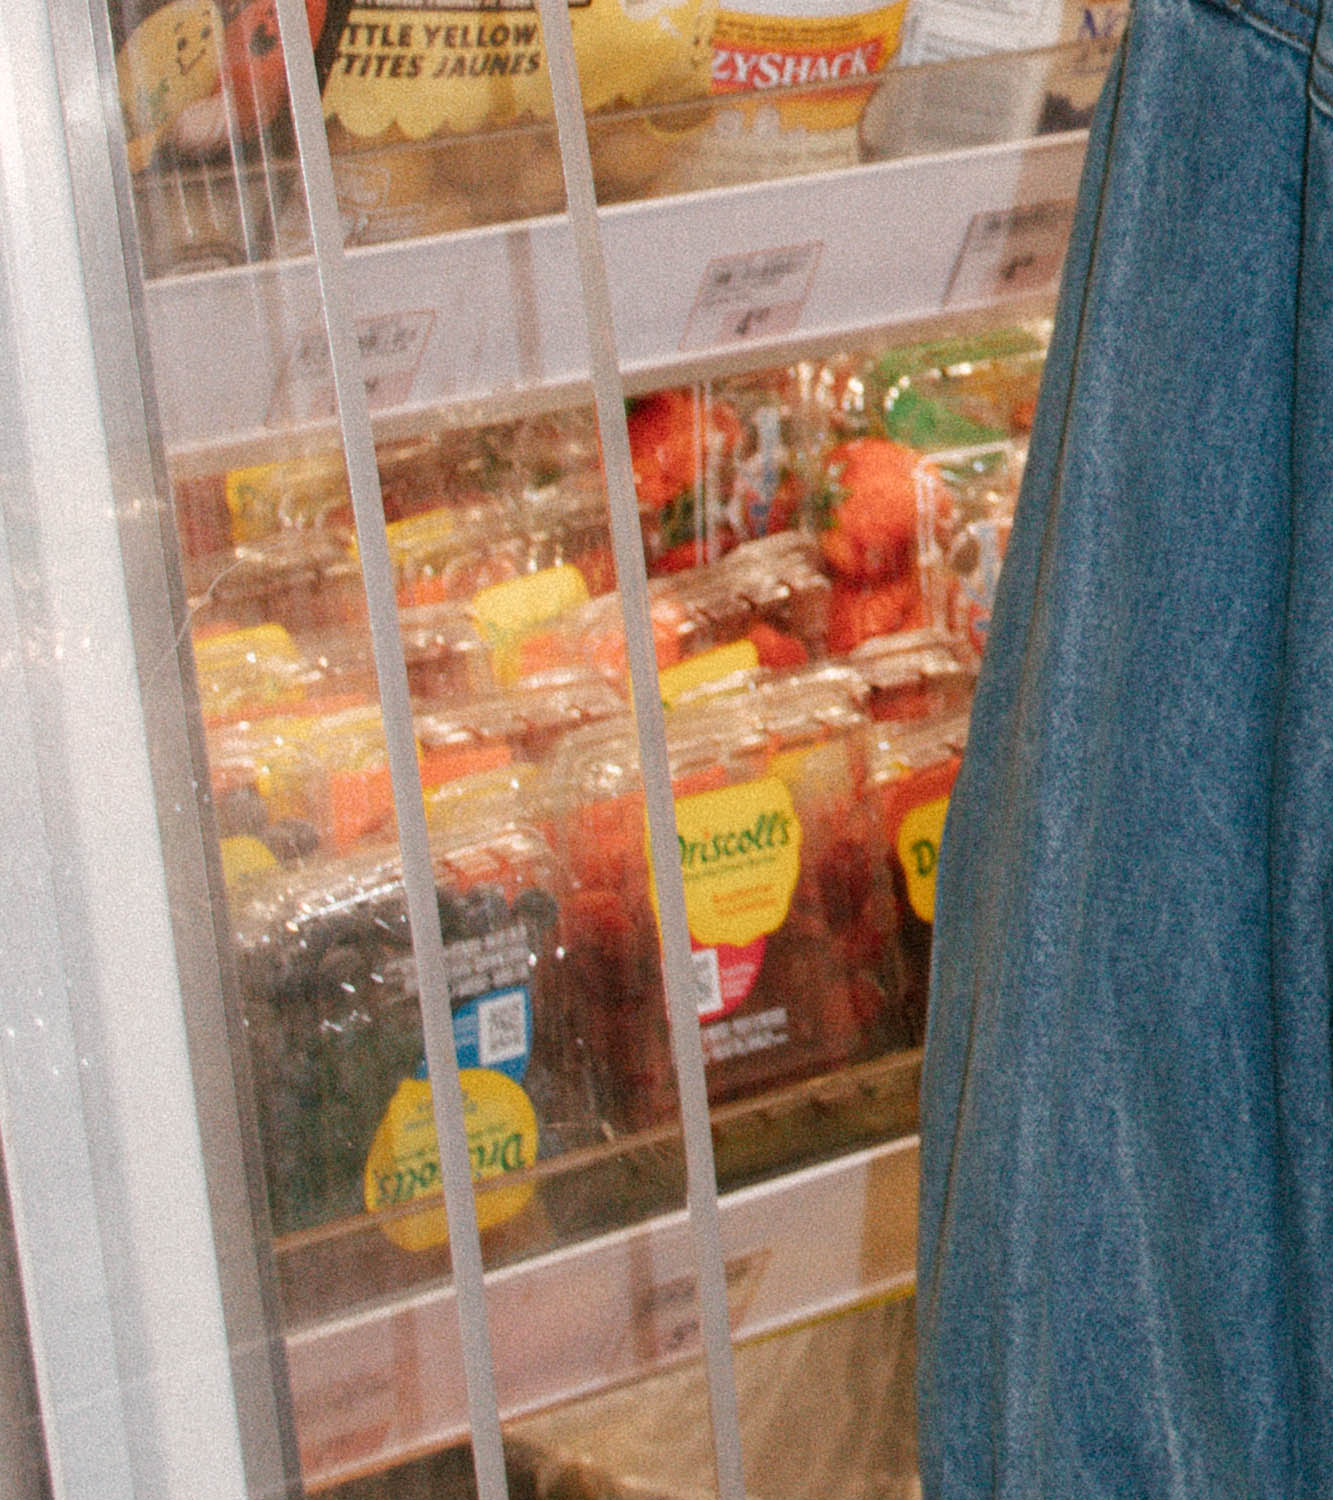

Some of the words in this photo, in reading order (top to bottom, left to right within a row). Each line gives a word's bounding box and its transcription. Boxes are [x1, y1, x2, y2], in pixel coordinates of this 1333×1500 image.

[348, 23, 413, 48] TTLE
[423, 22, 538, 48] YELLOW
[343, 52, 423, 78] TITES
[432, 51, 541, 78] JAUNES
[712, 45, 870, 90] ZYSHACK
